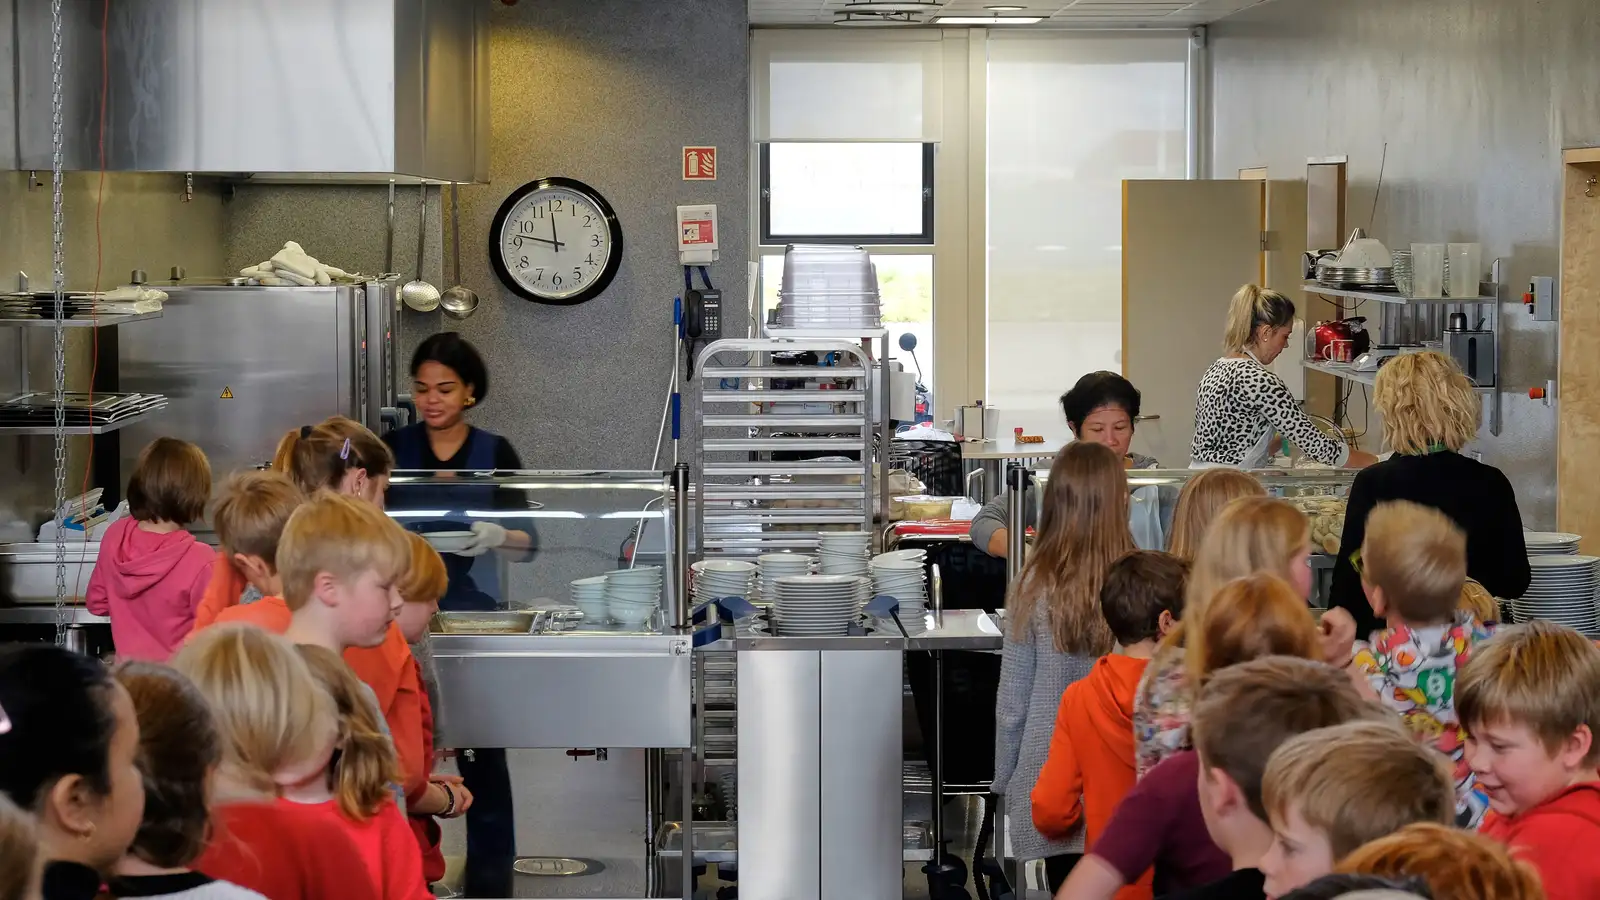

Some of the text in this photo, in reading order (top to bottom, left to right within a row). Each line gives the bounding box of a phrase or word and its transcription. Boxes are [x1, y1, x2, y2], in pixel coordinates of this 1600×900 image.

[532, 206, 544, 218] 11
[548, 200, 563, 212] 12
[572, 204, 576, 216] 1
[520, 220, 534, 233] 10
[582, 215, 592, 227] 2
[513, 236, 523, 250] 9
[590, 234, 600, 247] 3
[519, 255, 529, 268] 8
[584, 252, 594, 265] 4
[536, 268, 544, 280] 7
[552, 271, 562, 286] 6
[573, 267, 582, 280] 5
